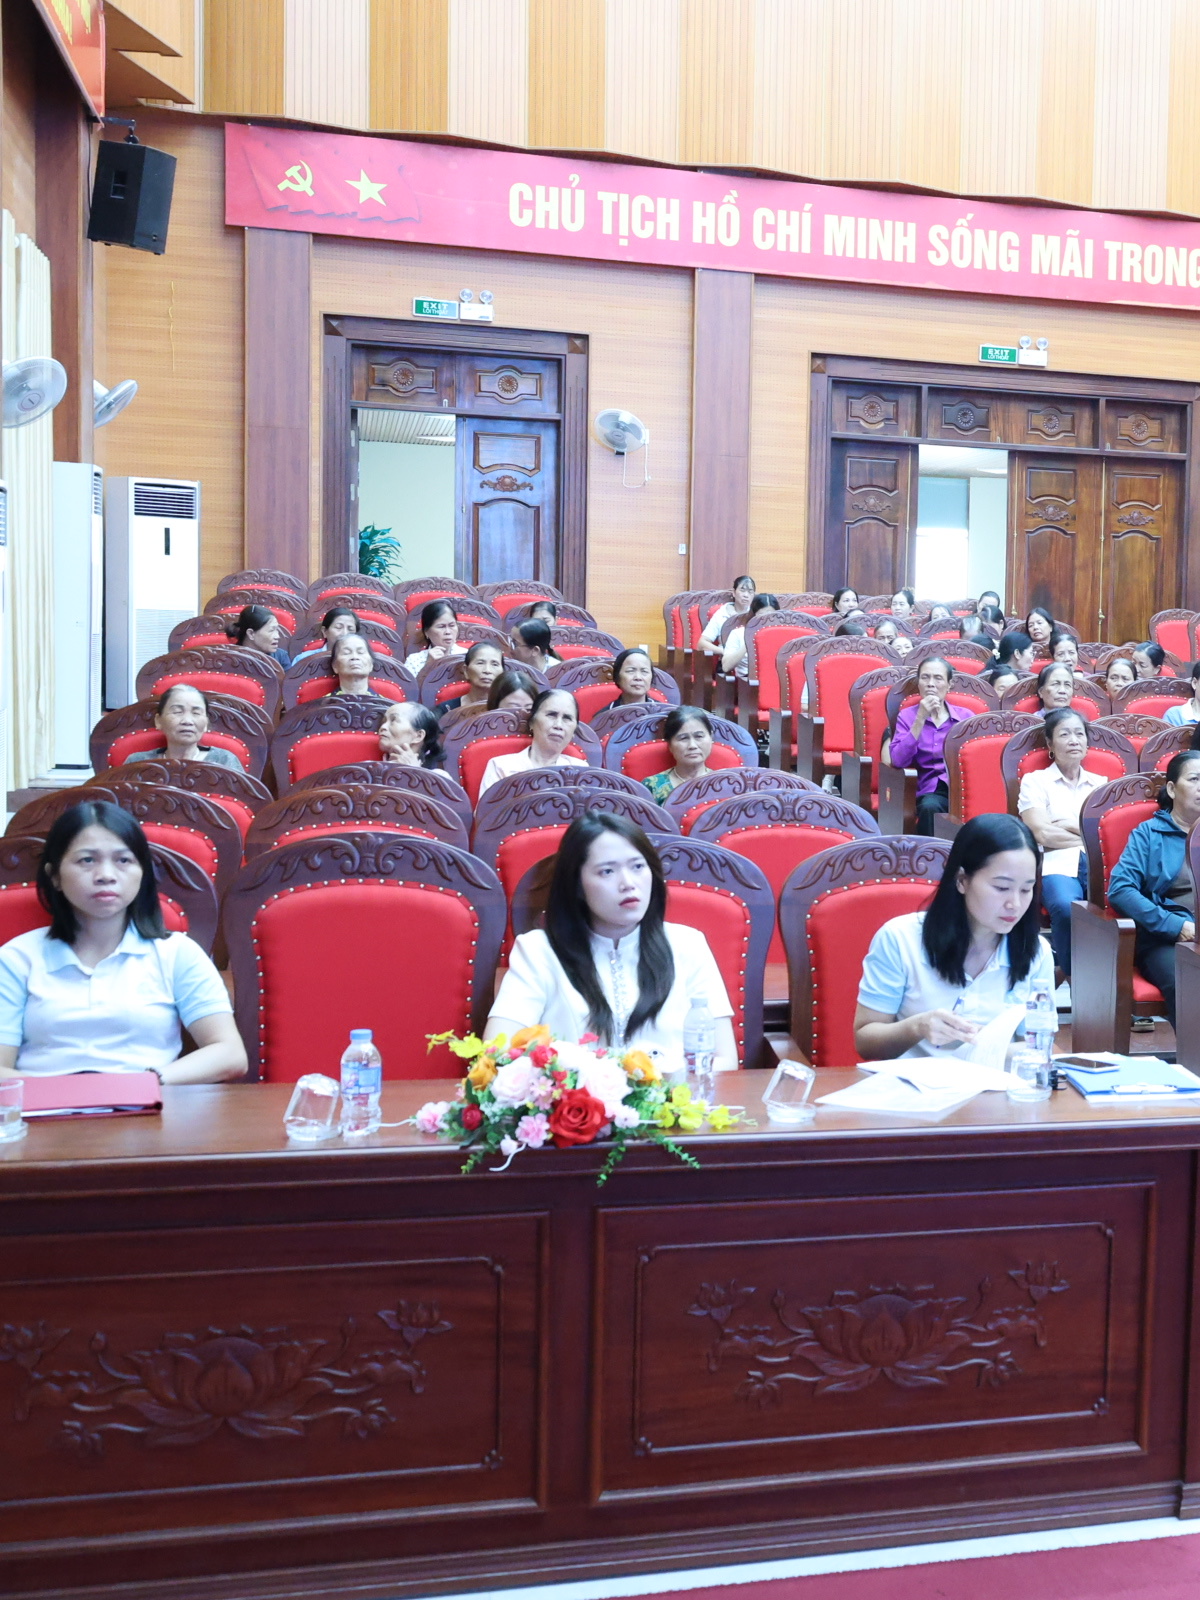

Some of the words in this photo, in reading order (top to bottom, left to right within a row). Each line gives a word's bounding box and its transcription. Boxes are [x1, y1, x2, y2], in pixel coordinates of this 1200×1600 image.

[508, 173, 584, 232] CHỦ
[597, 191, 680, 247] TỊCH
[692, 189, 740, 247] HỒ
[753, 202, 812, 254] CHÍ
[824, 214, 917, 264] MINH
[927, 211, 1020, 273] SỐNG
[1030, 227, 1093, 280] MÃI
